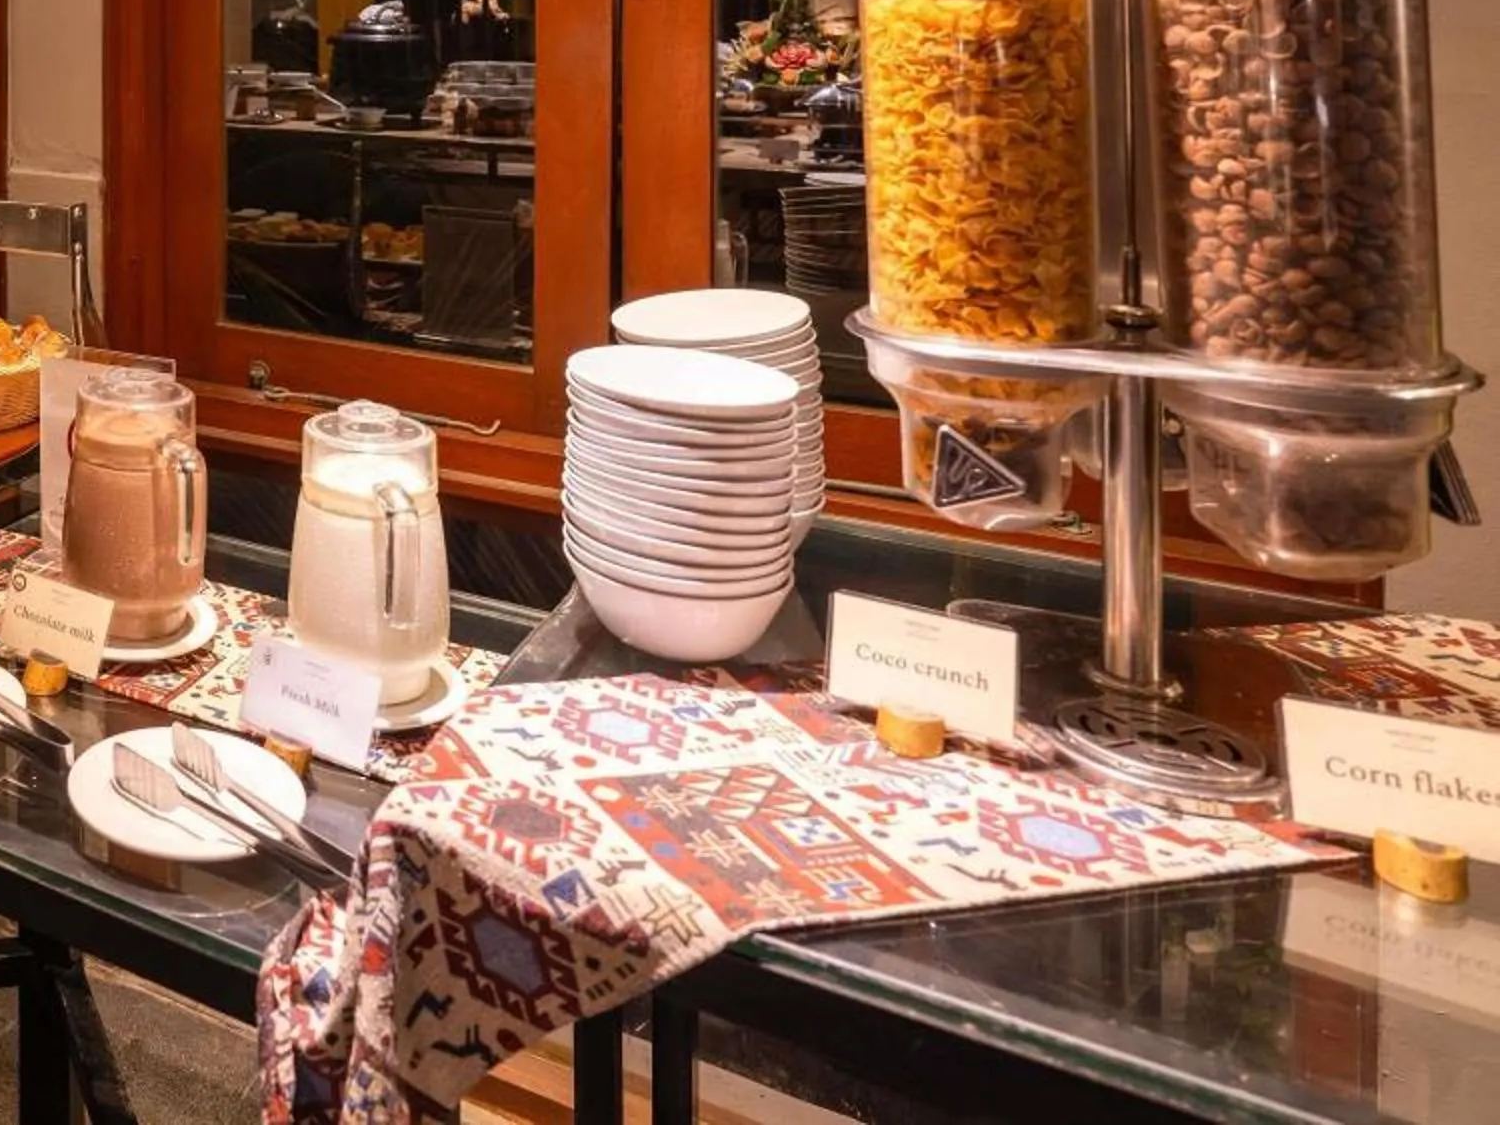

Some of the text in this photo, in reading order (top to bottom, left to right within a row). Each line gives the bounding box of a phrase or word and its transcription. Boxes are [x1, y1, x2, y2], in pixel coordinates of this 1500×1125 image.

[13, 605, 95, 644] Chocolate milk
[855, 642, 989, 692] Coco crunch
[281, 685, 340, 718] Fresh Milk
[1325, 756, 1402, 789] Corn
